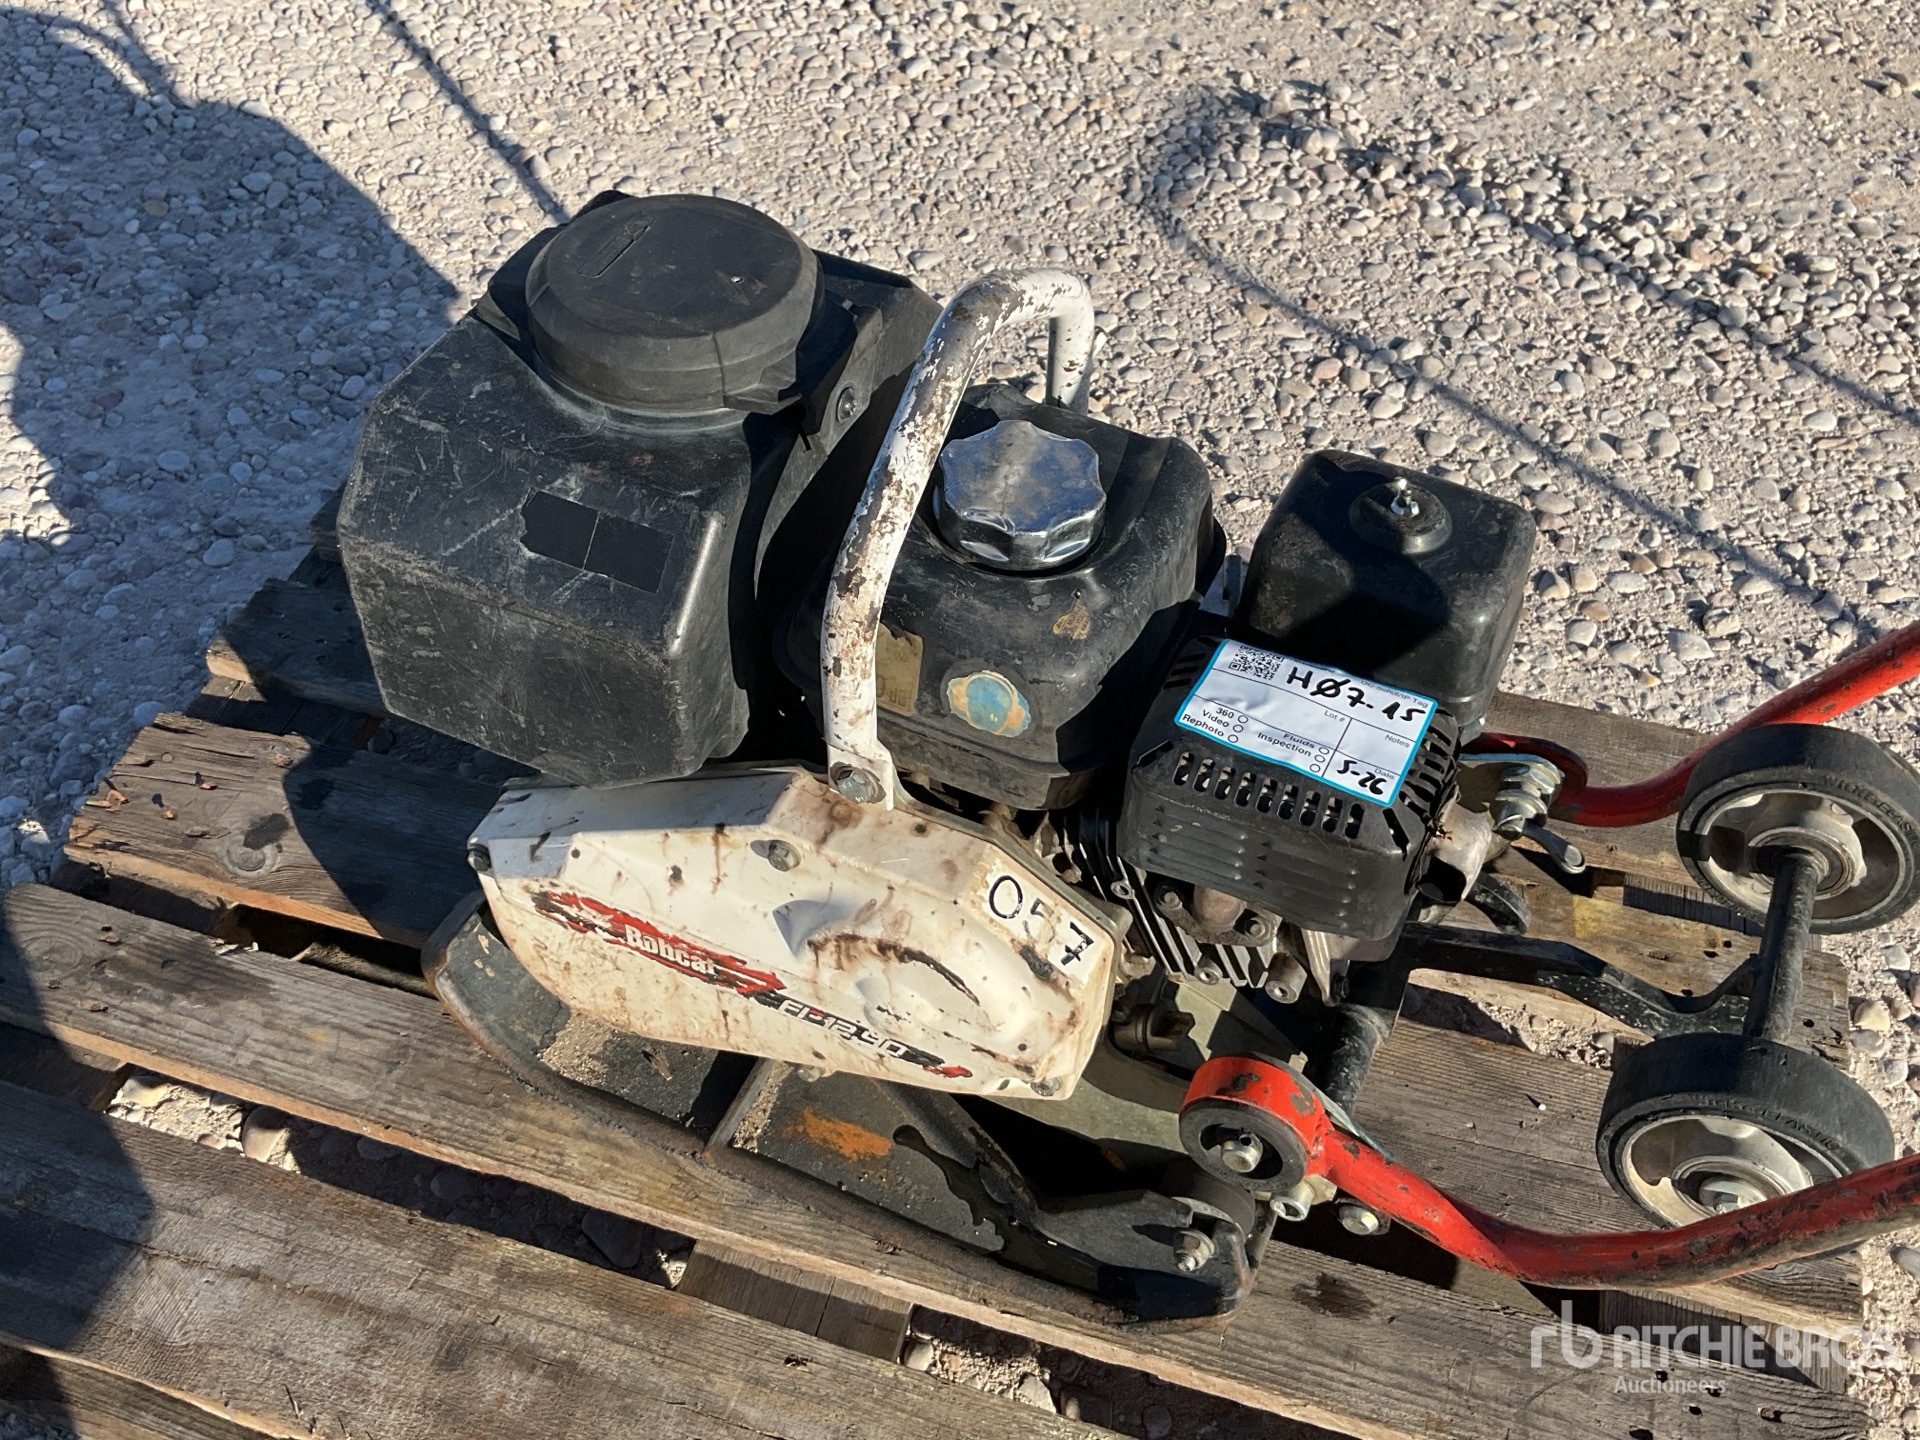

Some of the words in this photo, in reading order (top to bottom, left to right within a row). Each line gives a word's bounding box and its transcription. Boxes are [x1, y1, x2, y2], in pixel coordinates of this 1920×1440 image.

[1412, 697, 1429, 709] Tag
[1202, 709, 1230, 728] Video
[1215, 707, 1235, 719] 360
[1324, 710, 1338, 720] Lot
[1182, 713, 1225, 738] Rephoto
[1257, 732, 1312, 757] Inspection
[1283, 733, 1316, 749] Fluids
[1385, 734, 1410, 748] Notes
[1374, 768, 1395, 780] Date
[625, 924, 716, 974] Bobcat
